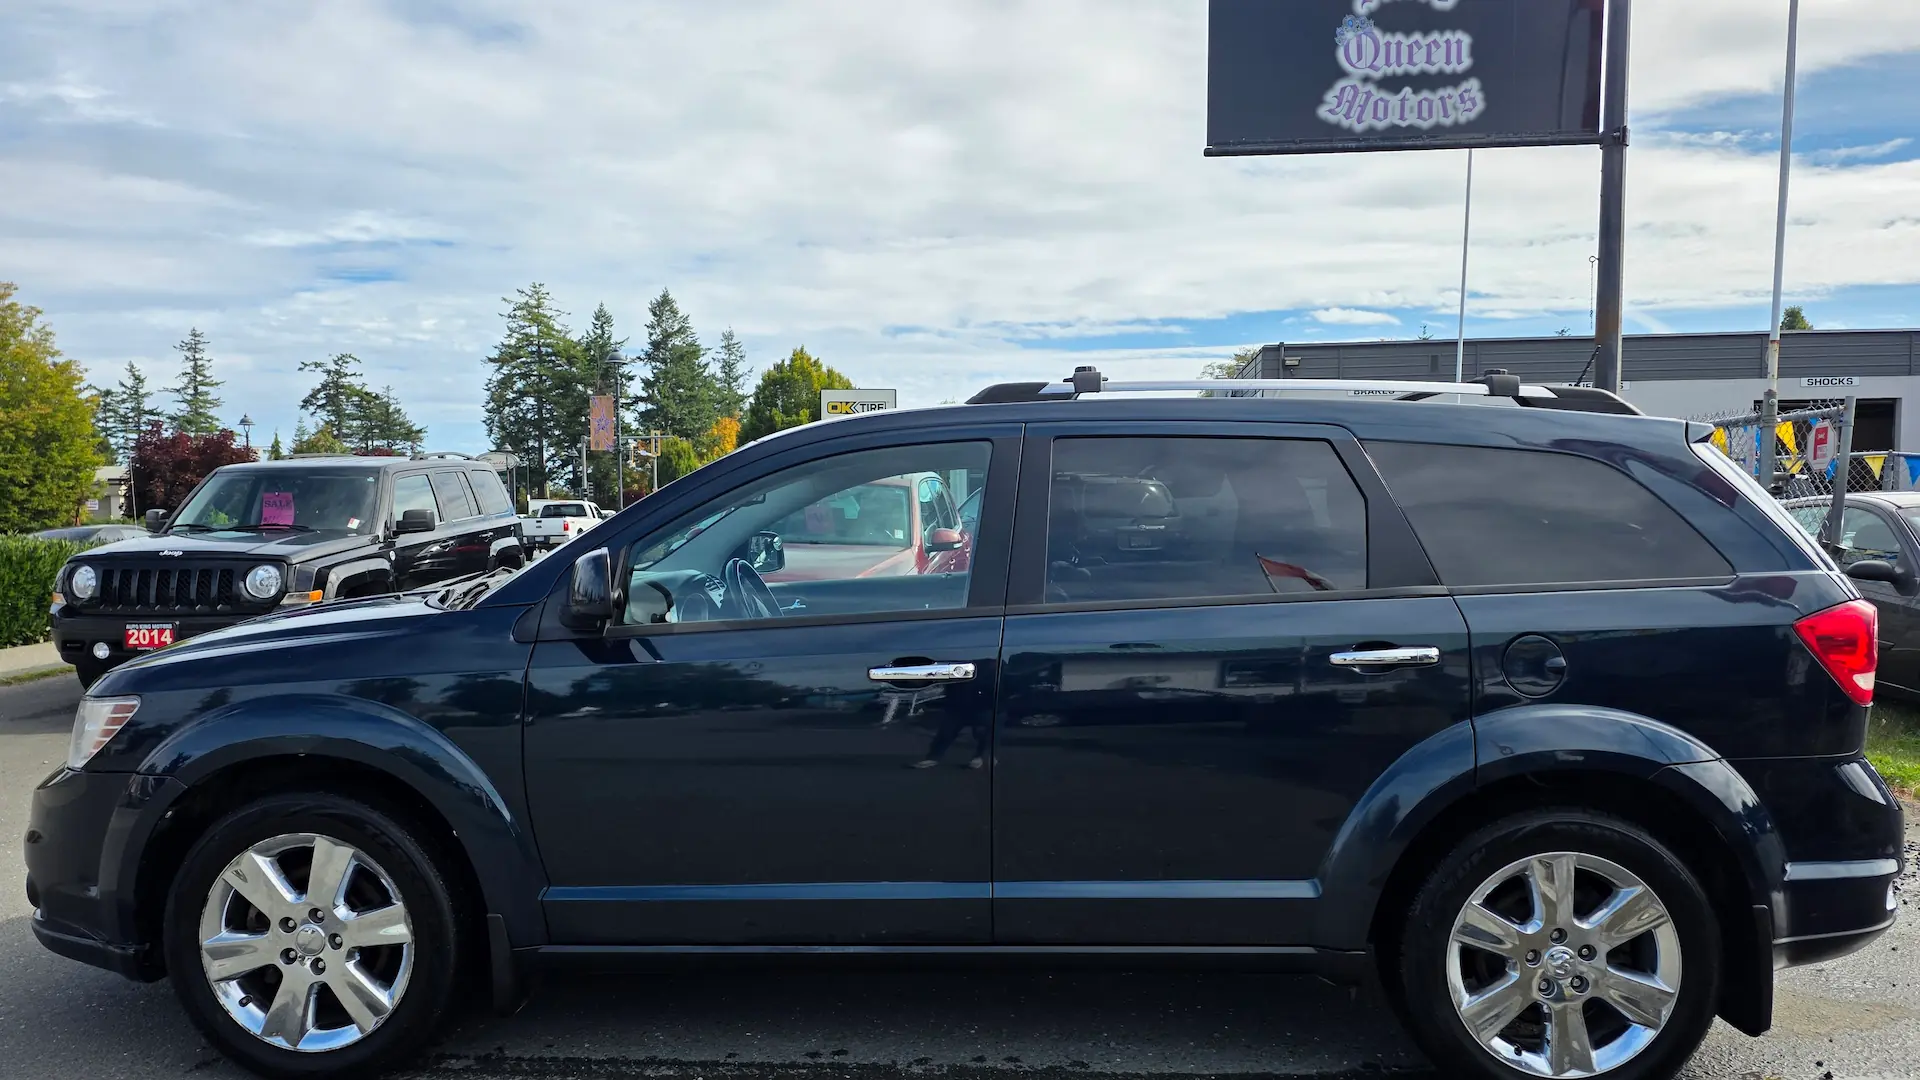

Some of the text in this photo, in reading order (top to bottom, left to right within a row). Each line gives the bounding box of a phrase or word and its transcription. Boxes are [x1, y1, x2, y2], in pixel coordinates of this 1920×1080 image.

[1343, 28, 1465, 73] Queen
[1326, 83, 1480, 125] Motors
[1806, 377, 1854, 386] SHOCKS
[827, 401, 857, 414] OK
[128, 629, 173, 645] 2014
